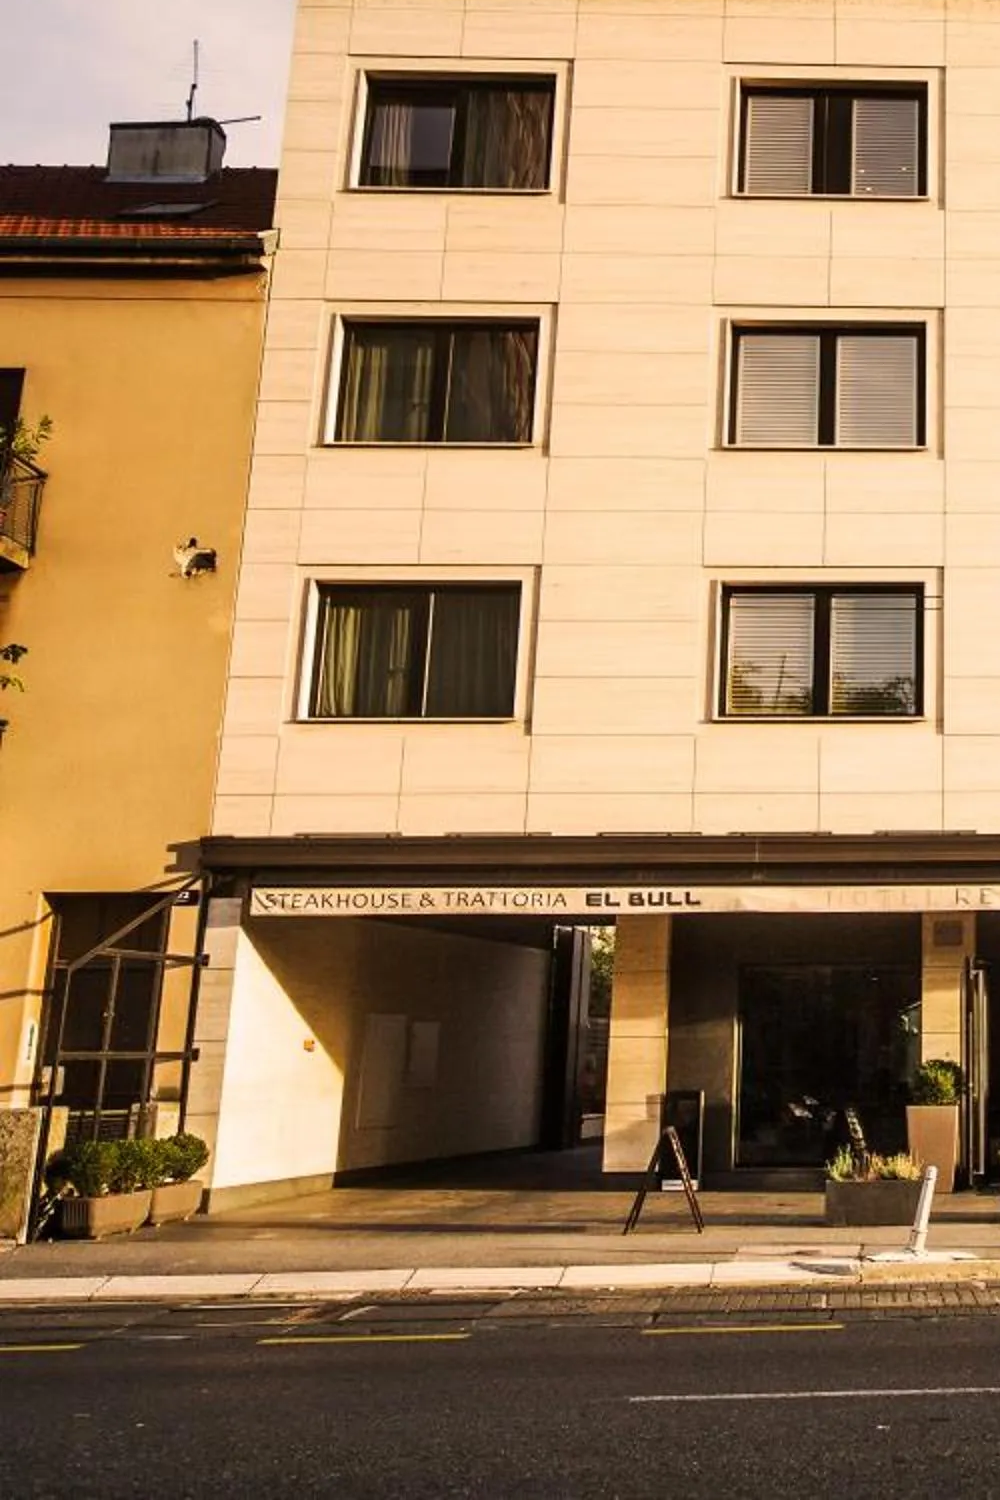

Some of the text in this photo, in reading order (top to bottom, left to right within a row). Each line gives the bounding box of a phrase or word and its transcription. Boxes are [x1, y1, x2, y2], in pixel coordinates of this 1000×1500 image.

[265, 891, 702, 909] STEAKHOUSE & TRATTORIA EL BULL
